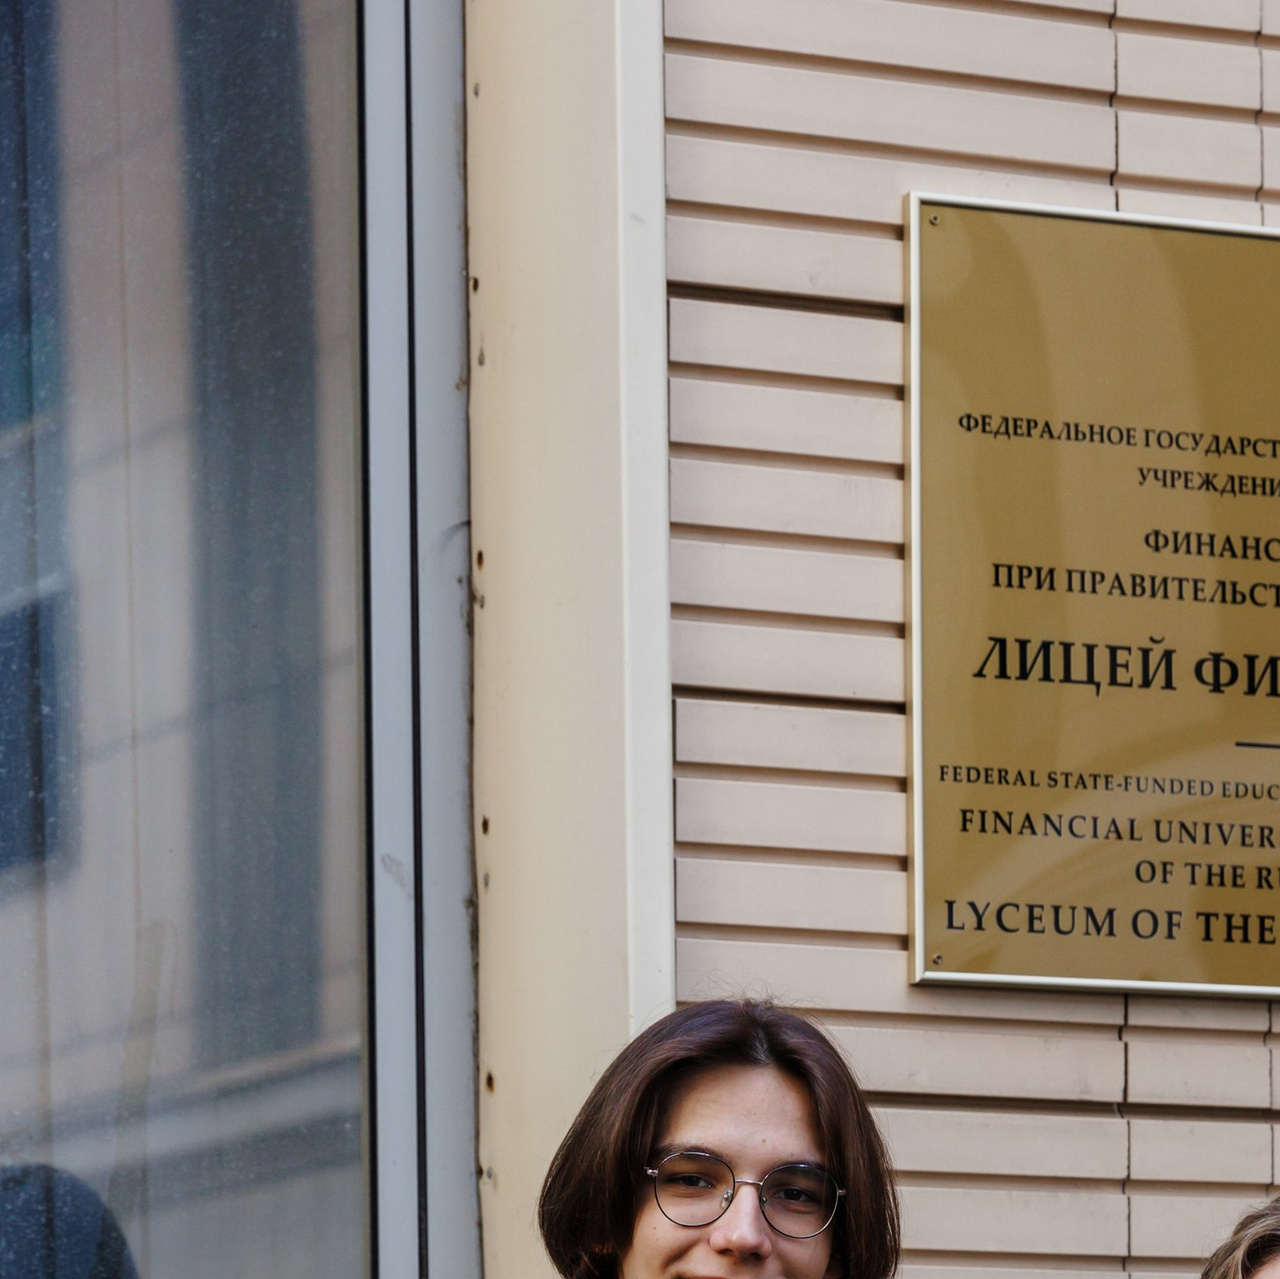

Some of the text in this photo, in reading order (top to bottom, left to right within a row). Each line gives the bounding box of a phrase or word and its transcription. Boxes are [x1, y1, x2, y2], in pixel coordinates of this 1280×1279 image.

[958, 413, 1137, 446] ФЕДЕРАЛЬНОЕ
[992, 563, 1056, 592] ПРИ
[972, 636, 1177, 697] ЛИЦЕЙ
[939, 765, 1040, 787] FEDERAL
[1048, 771, 1214, 796] STATE-FUNDED
[960, 809, 1142, 841] FINANCIAL
[1135, 860, 1174, 884] OF
[1184, 862, 1245, 888] THE
[944, 900, 1116, 937] LYCEUM
[1131, 909, 1182, 940] OF
[1196, 912, 1276, 945] THE
